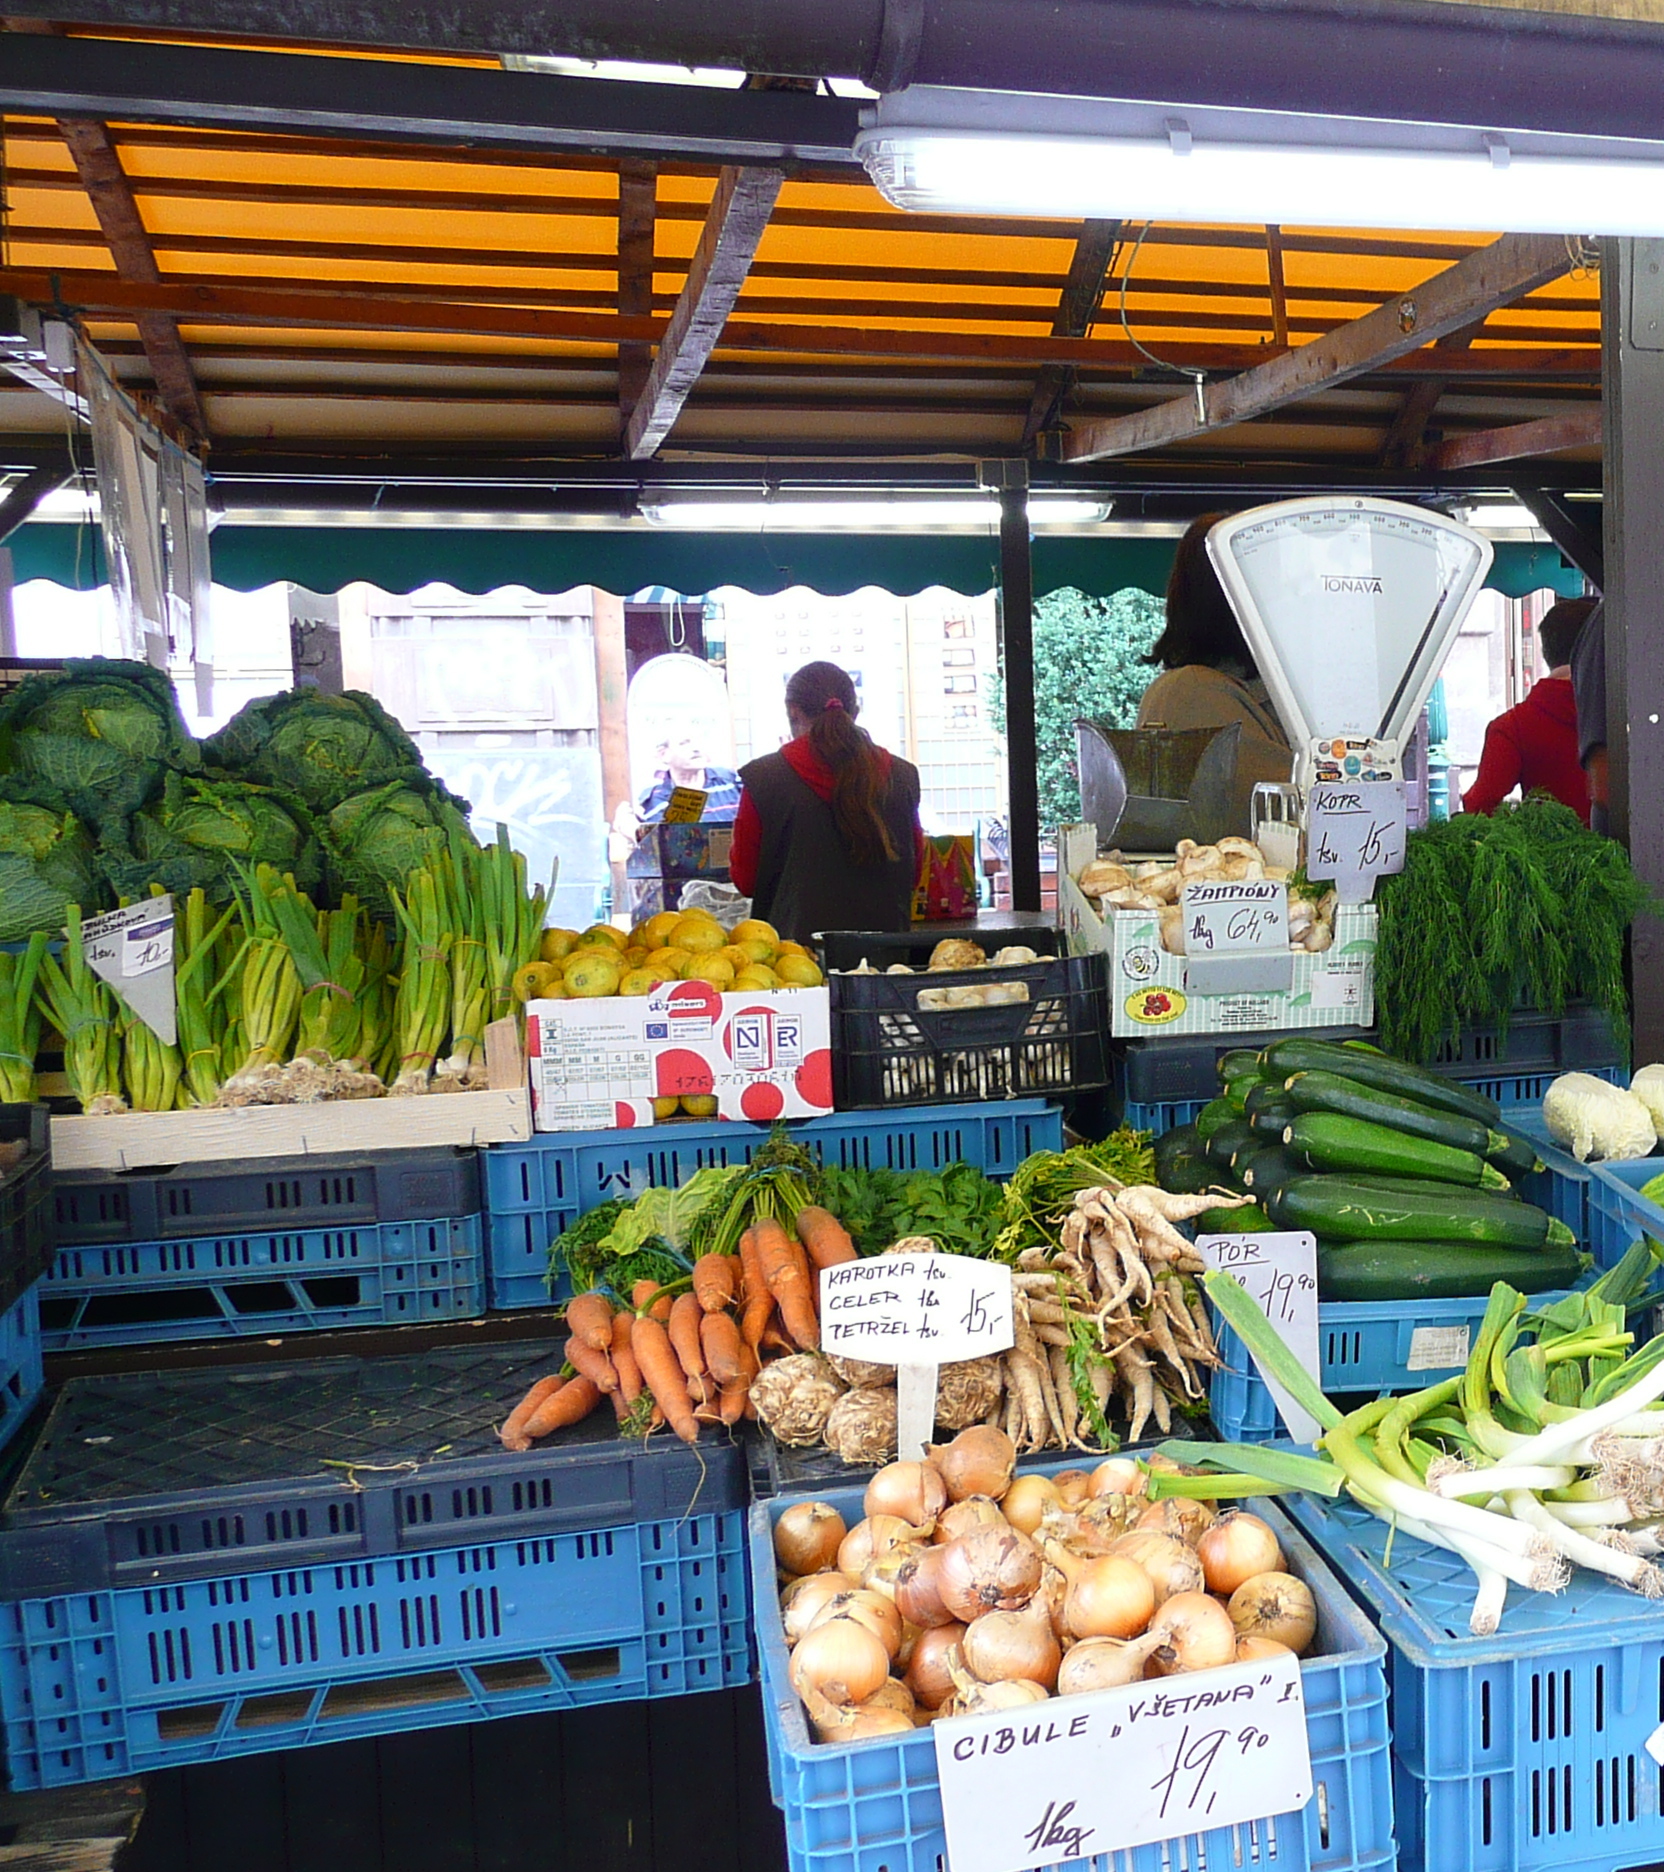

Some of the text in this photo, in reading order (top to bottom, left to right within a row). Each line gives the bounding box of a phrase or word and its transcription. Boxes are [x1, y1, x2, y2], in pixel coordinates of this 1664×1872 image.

[1321, 575, 1383, 594] TONAVA
[1316, 791, 1362, 811] KOPR
[1187, 881, 1281, 901] ŽAMPIÓNY
[1207, 1235, 1261, 1263] PÓR
[828, 1262, 915, 1289] KAROTKA
[829, 1291, 902, 1310] CELER
[828, 1315, 910, 1340] PETRŽEL
[953, 1714, 1090, 1761] CIBULE
